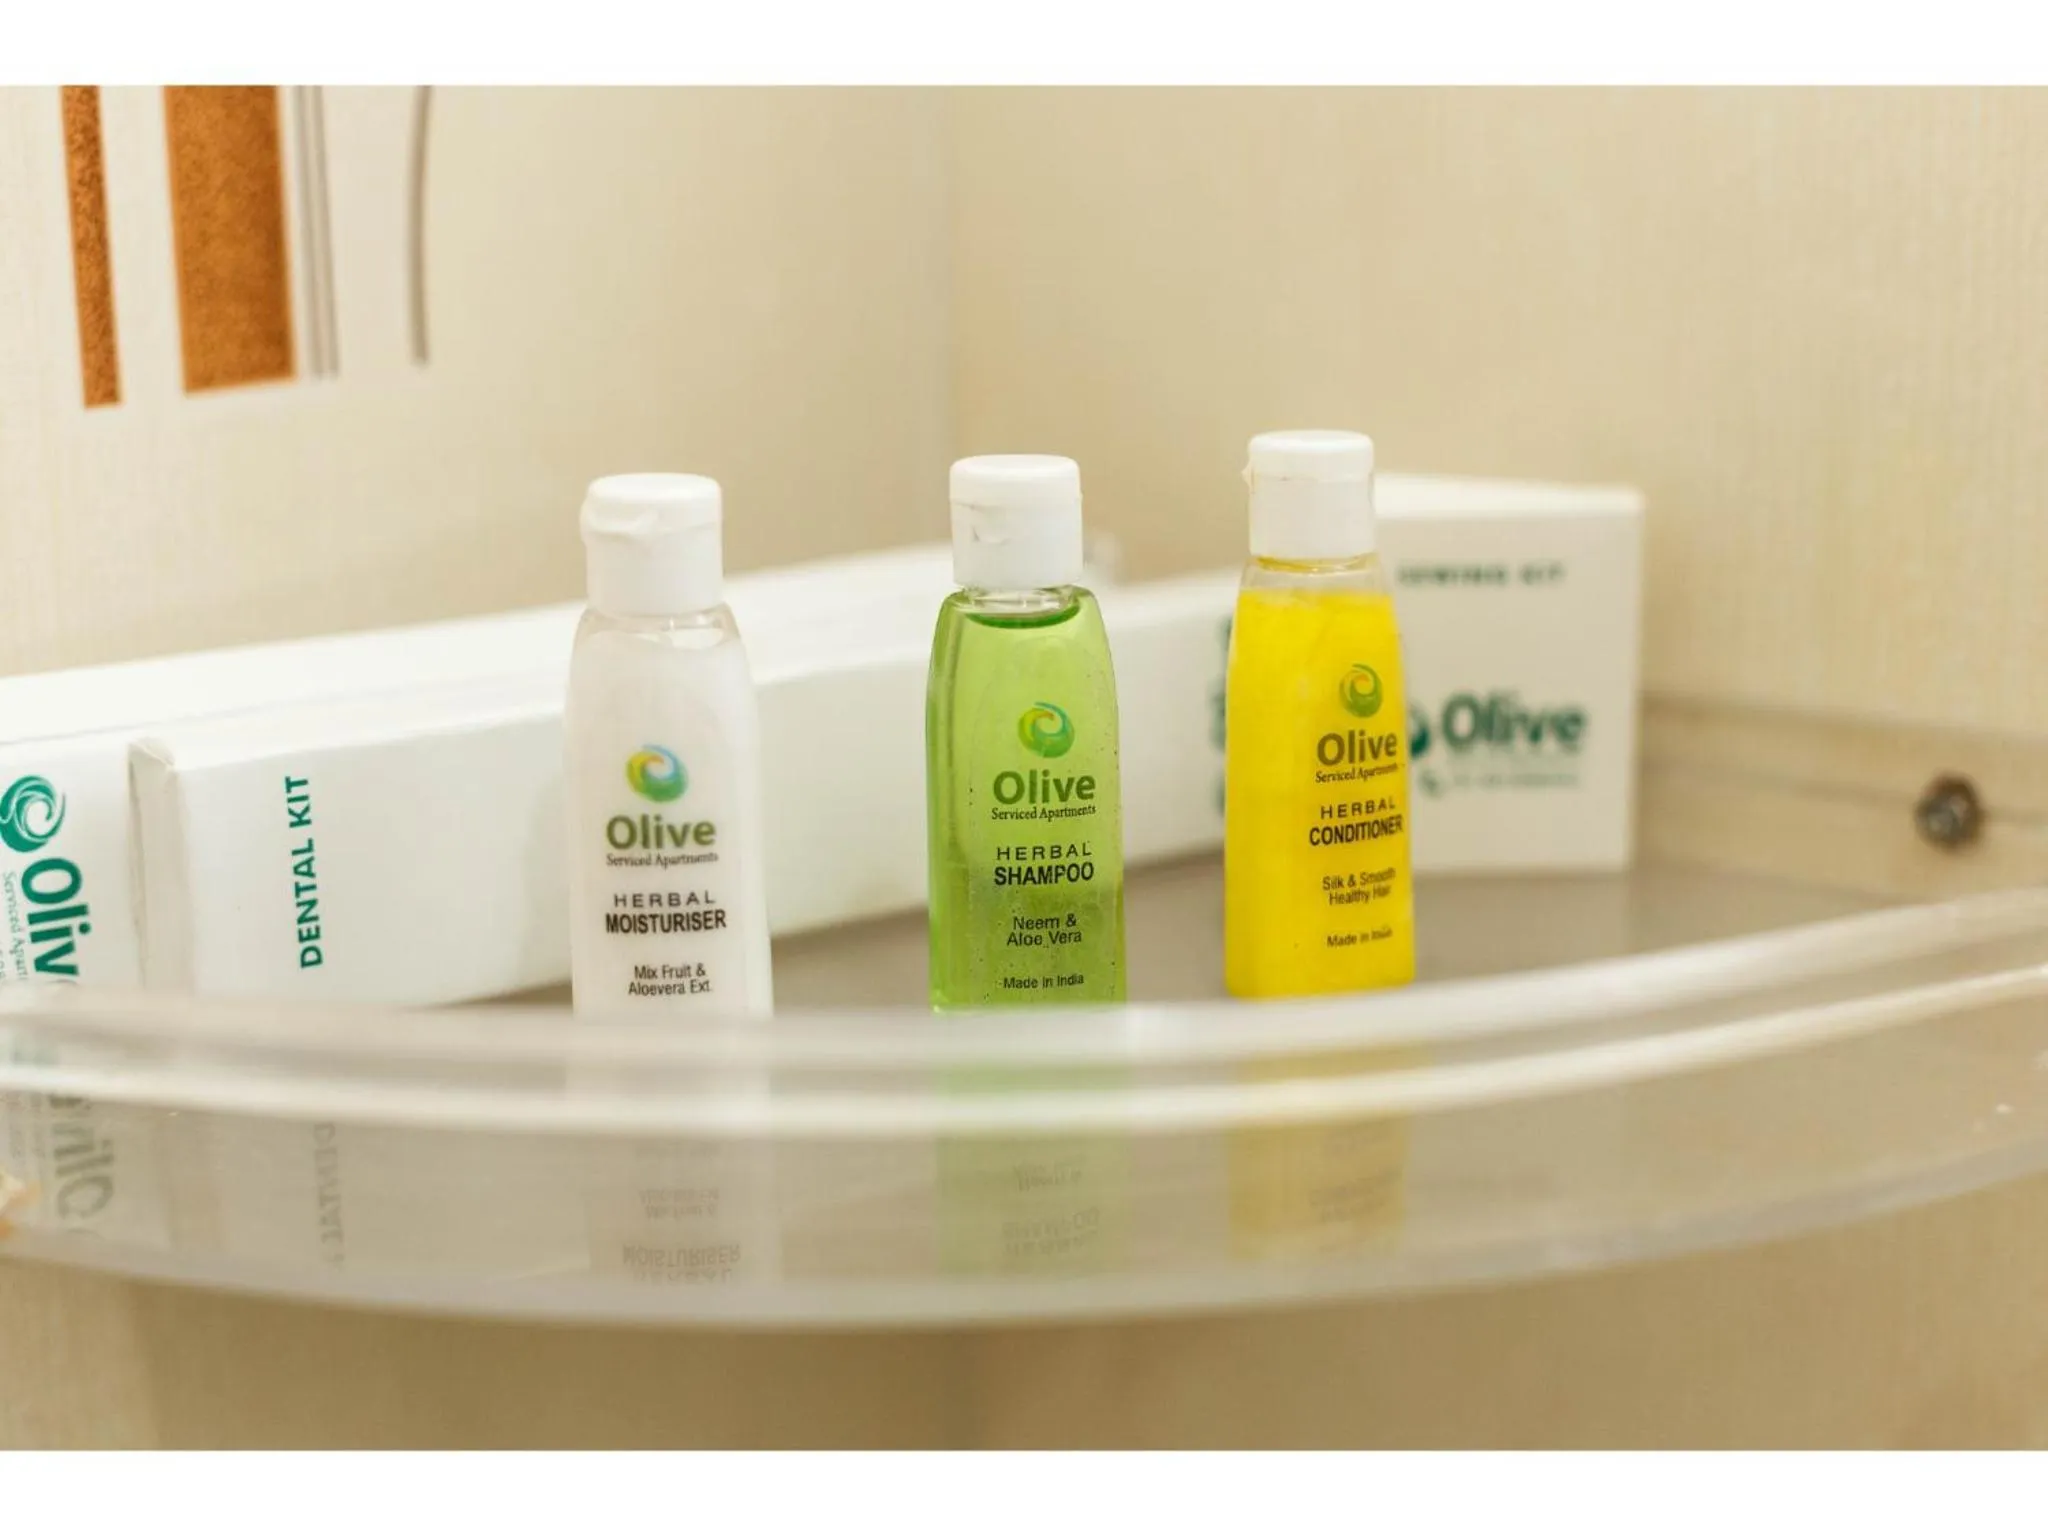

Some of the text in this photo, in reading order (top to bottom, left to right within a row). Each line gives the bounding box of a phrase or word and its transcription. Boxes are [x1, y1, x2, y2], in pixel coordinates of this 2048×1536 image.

[1440, 690, 1587, 752] Olive
[1316, 729, 1398, 767] Olive
[1315, 767, 1356, 784] Serviced
[992, 769, 1096, 805] Olive
[991, 804, 1097, 822] Serviced Apartments
[1320, 798, 1396, 820] HERBAL
[605, 814, 717, 850] Olive
[1308, 814, 1404, 846] CONDITIONER
[605, 852, 719, 870] Serviced Apartments
[996, 843, 1092, 861] HERBAL
[284, 776, 324, 969] DENTAL KIT
[994, 861, 1095, 886] SHAMPOO
[1322, 876, 1345, 891] Silk
[1347, 874, 1357, 888] &
[613, 890, 716, 908] HERBAL
[1329, 889, 1370, 905] Healthy
[21, 857, 91, 984] Oliv
[605, 909, 727, 935] MOISTURISER
[1013, 913, 1077, 930] Neem &
[1007, 930, 1082, 946] Aloe Vera
[1327, 934, 1358, 949] Made
[634, 962, 707, 980] Mix Fruit &
[628, 979, 686, 997] Aloevera
[1003, 973, 1084, 989] Made in India
